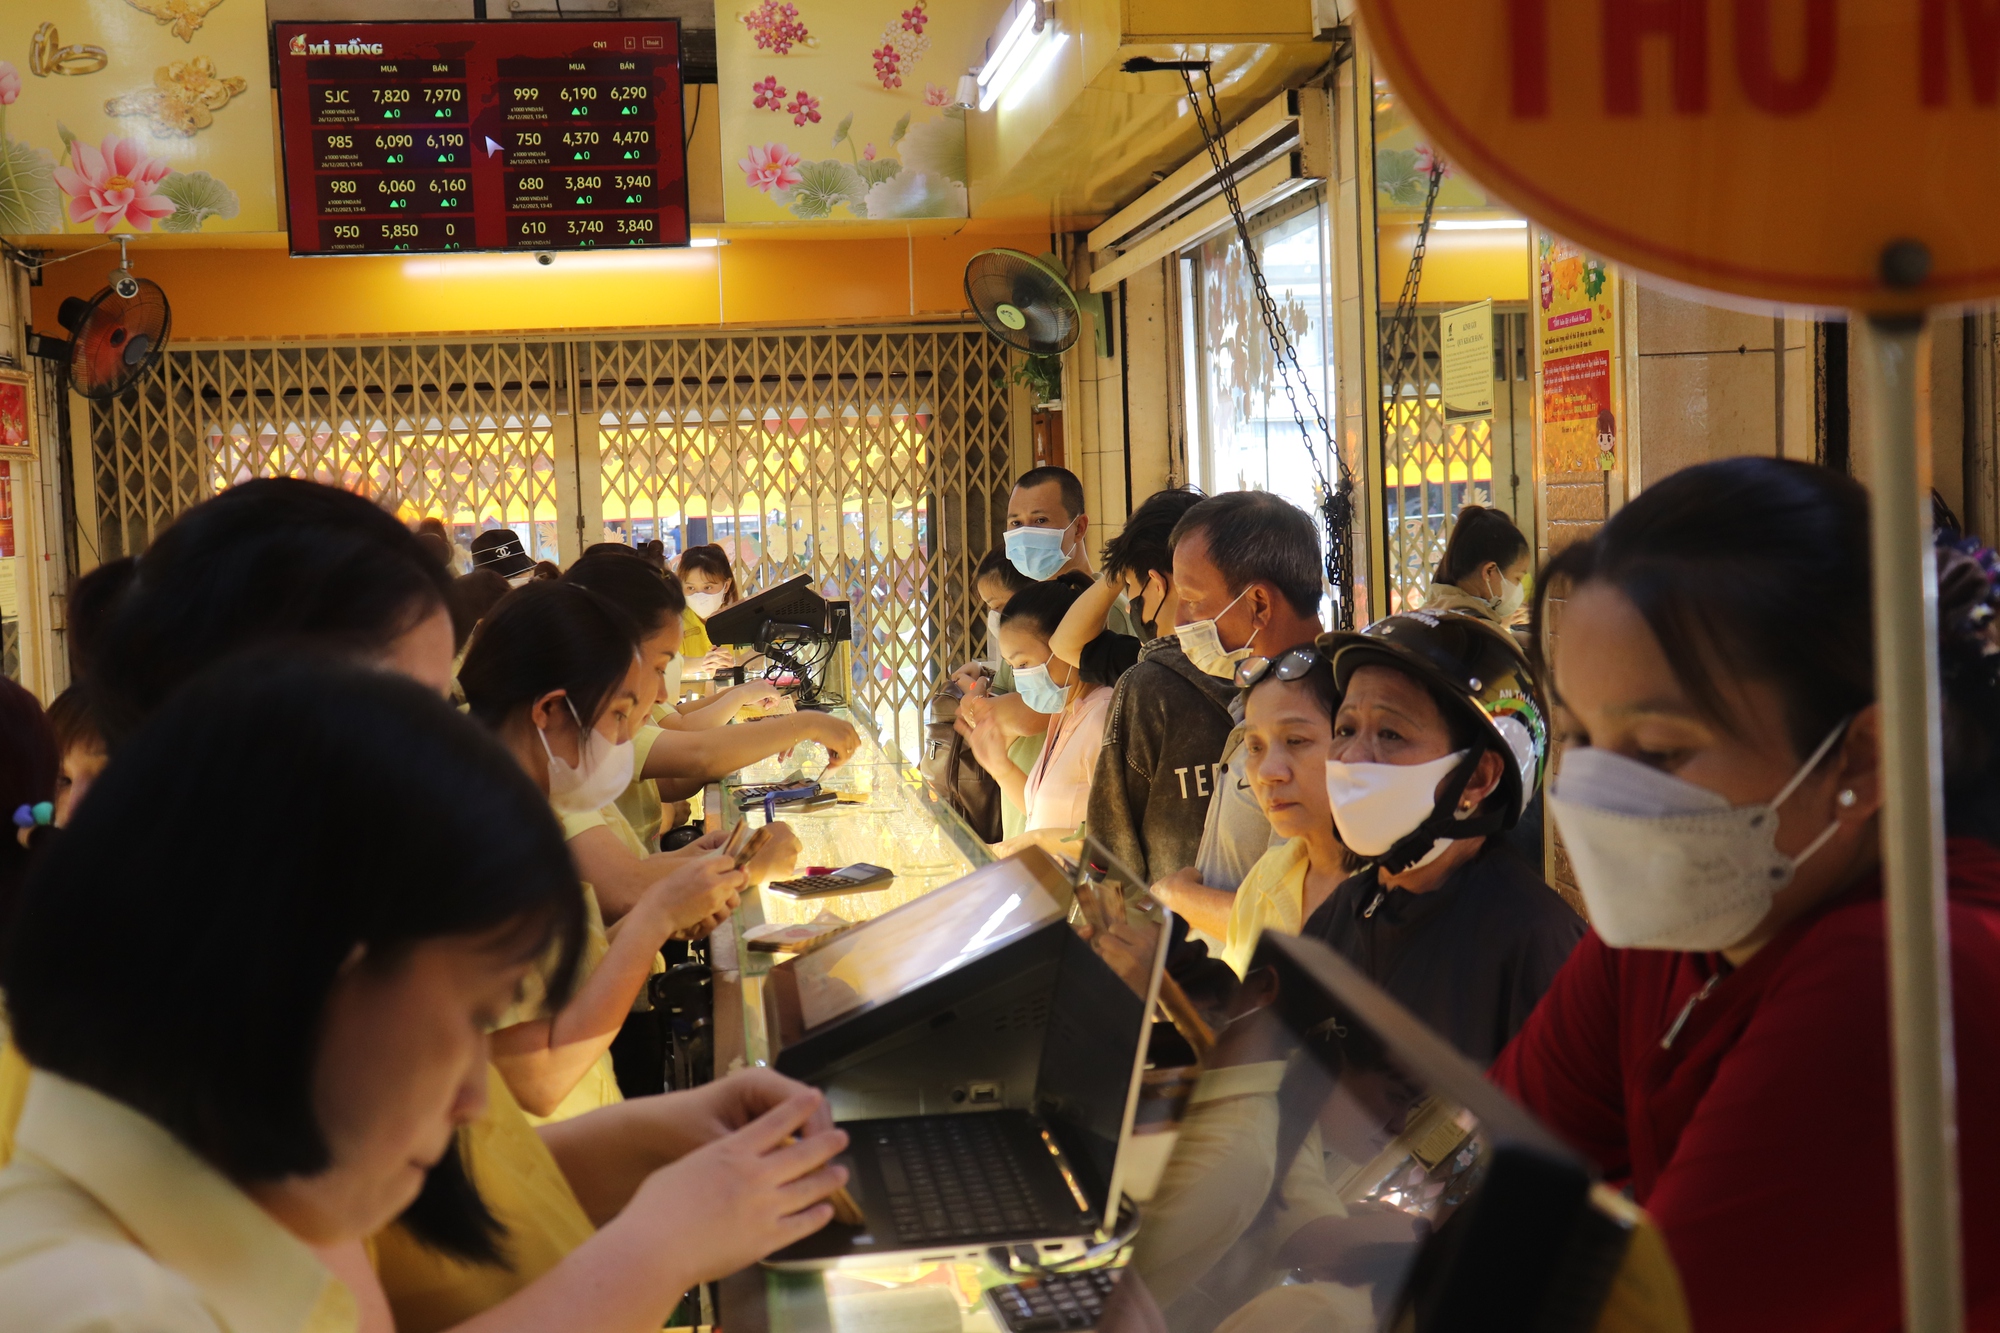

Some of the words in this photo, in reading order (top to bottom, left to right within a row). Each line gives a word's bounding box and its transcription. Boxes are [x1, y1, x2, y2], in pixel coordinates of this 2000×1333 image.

[433, 64, 448, 72] BÁN
[620, 61, 635, 69] BÁN
[325, 90, 349, 103] SJC
[372, 90, 410, 104] 7,820
[424, 89, 461, 104] 7,970
[514, 88, 538, 100] 999
[561, 87, 597, 102] 6,190
[611, 87, 646, 101] 6,290
[394, 109, 400, 118] 0
[445, 108, 451, 117] 0
[581, 107, 588, 115] 0
[631, 106, 638, 114] 0
[328, 136, 353, 148] 985
[376, 135, 412, 149] 6,090
[427, 134, 463, 149] 6,190
[516, 133, 541, 145] 750
[563, 132, 599, 146] 4,370
[613, 131, 649, 145] 4,470
[397, 154, 403, 163] 0
[448, 153, 454, 162] 0
[584, 151, 590, 160] 0
[634, 150, 640, 159] 0
[331, 181, 356, 193] 980
[379, 180, 415, 194] 6,060
[430, 179, 466, 193] 6,160
[519, 178, 543, 190] 680
[565, 176, 601, 191] 3,840
[615, 175, 651, 190] 3,940
[400, 199, 406, 208] 0
[451, 198, 457, 207] 0
[586, 195, 593, 204] 0
[636, 194, 642, 203] 0
[334, 226, 359, 238] 950
[382, 224, 418, 239] 5,850
[445, 224, 455, 236] 0
[522, 222, 546, 234] 610
[567, 221, 603, 235] 3,740
[617, 219, 653, 234] 3,840
[1500, 689, 1512, 699] AN
